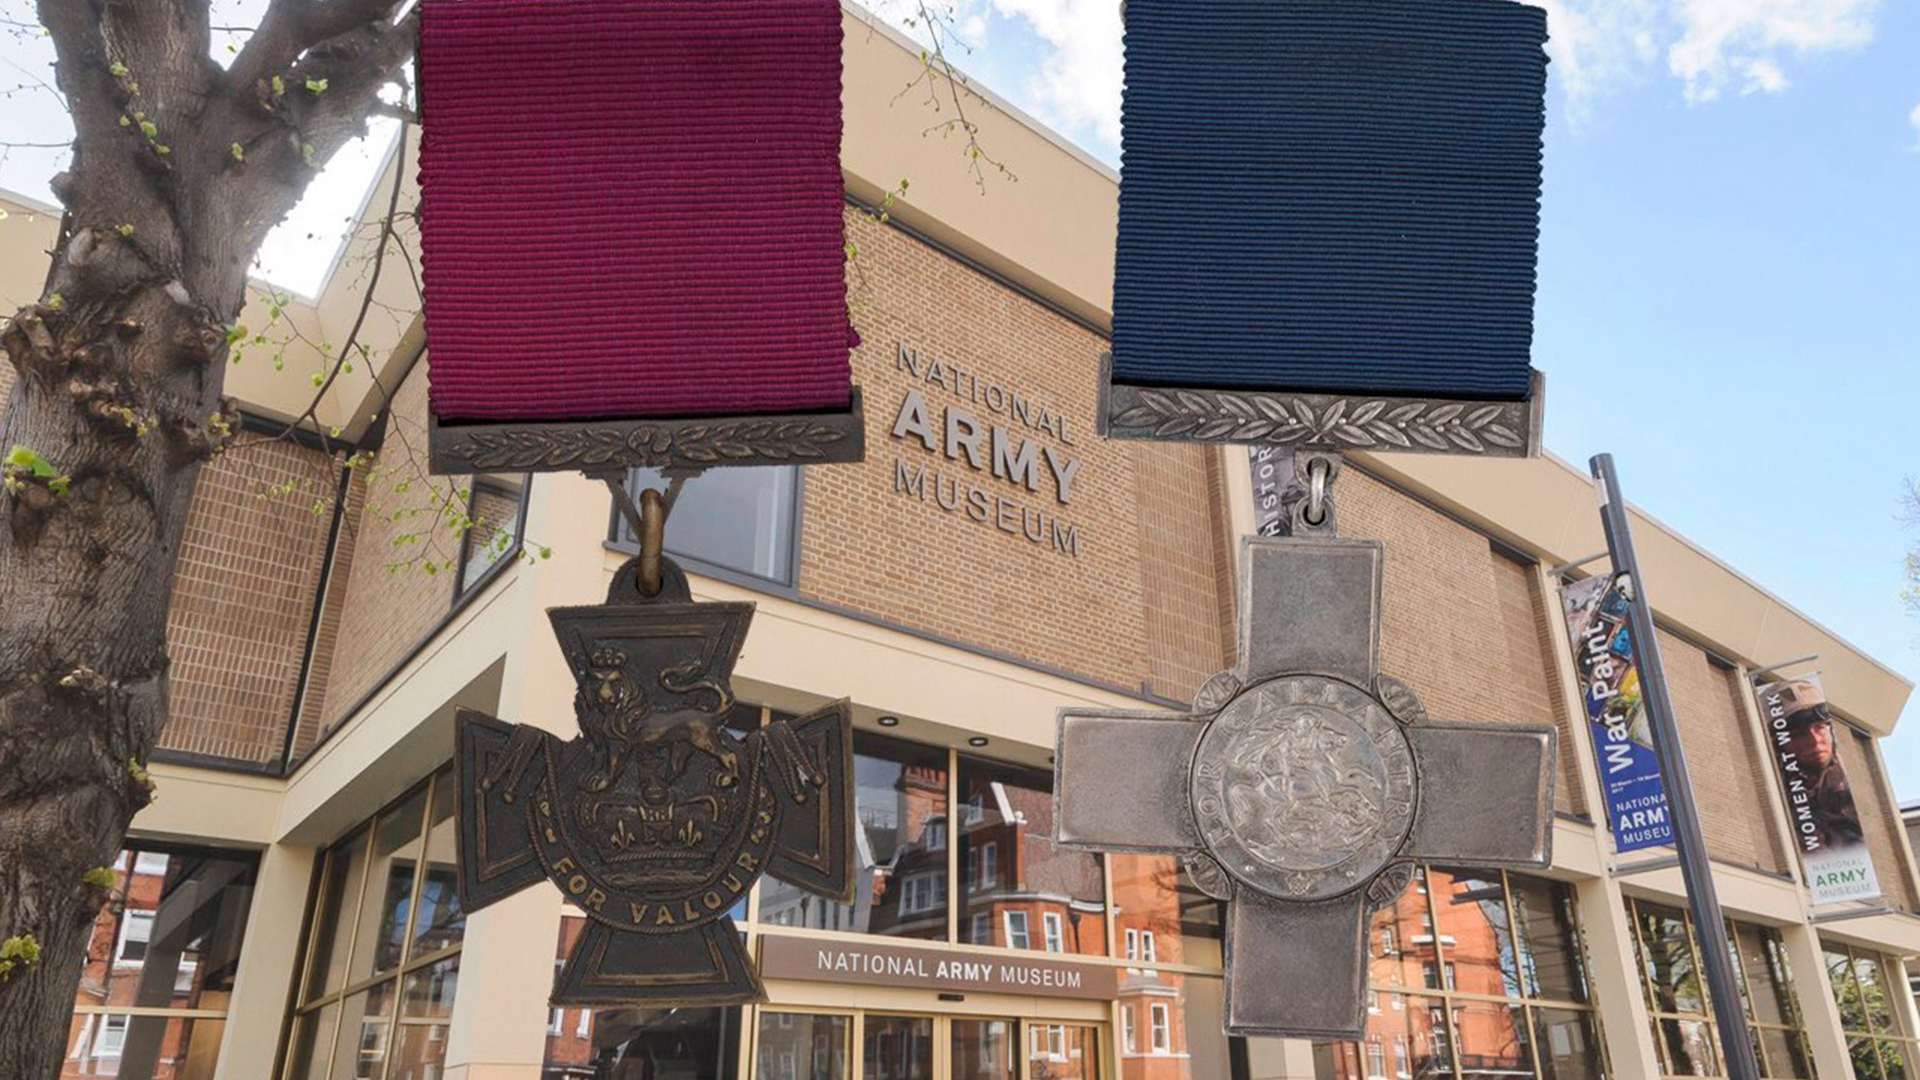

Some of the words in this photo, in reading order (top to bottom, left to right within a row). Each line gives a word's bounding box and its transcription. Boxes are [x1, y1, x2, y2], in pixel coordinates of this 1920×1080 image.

[897, 341, 1074, 447] NATIONAL
[891, 390, 1080, 504] ARMY
[894, 458, 1080, 557] MUSEUM
[1257, 446, 1280, 537] HISTOR
[1586, 620, 1618, 701] Paint
[1604, 712, 1634, 774] War
[1766, 693, 1791, 746] WORK
[1781, 752, 1800, 772] AT
[1616, 793, 1667, 812] NATIONA
[1620, 806, 1669, 831] ARM
[1789, 780, 1820, 851] WOMEN
[1623, 826, 1671, 844] MUSEU
[552, 857, 607, 912] FOR
[628, 852, 759, 926] VALOUR
[1812, 857, 1864, 871] NATIONAL
[1816, 867, 1867, 887] ARMY
[1819, 883, 1870, 897] MUSEUM
[818, 950, 928, 977] NATIONAL
[936, 960, 993, 982] ARMY
[1001, 965, 1081, 989] MUSEUM
